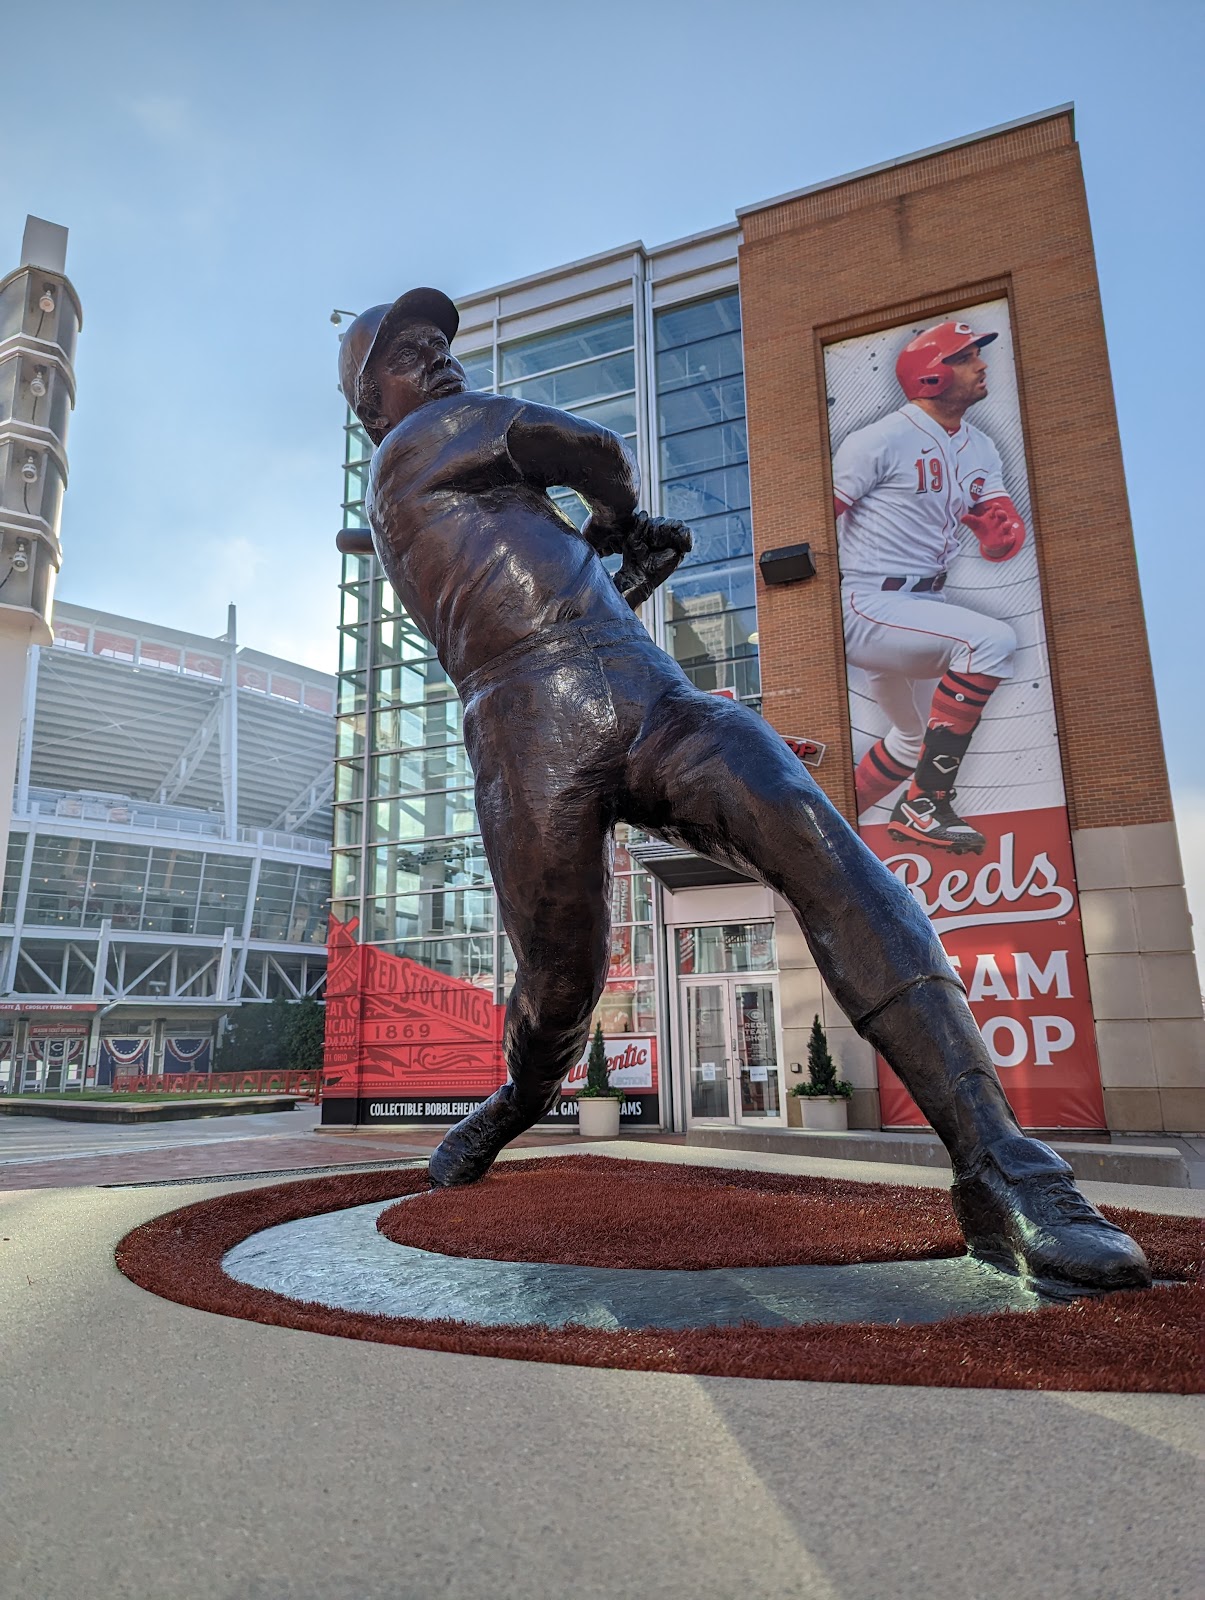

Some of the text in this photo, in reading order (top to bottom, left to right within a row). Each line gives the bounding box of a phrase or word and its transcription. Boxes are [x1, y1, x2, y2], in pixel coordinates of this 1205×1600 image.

[914, 457, 943, 494] 19
[883, 832, 1074, 935] Reds
[365, 946, 491, 1030] RED STOCKINGS
[947, 950, 1074, 1002] AM
[375, 1023, 431, 1039] 1869
[980, 1015, 1076, 1068] OP
[369, 1102, 423, 1116] COLLECTIBLE
[560, 1101, 579, 1116] GAM
